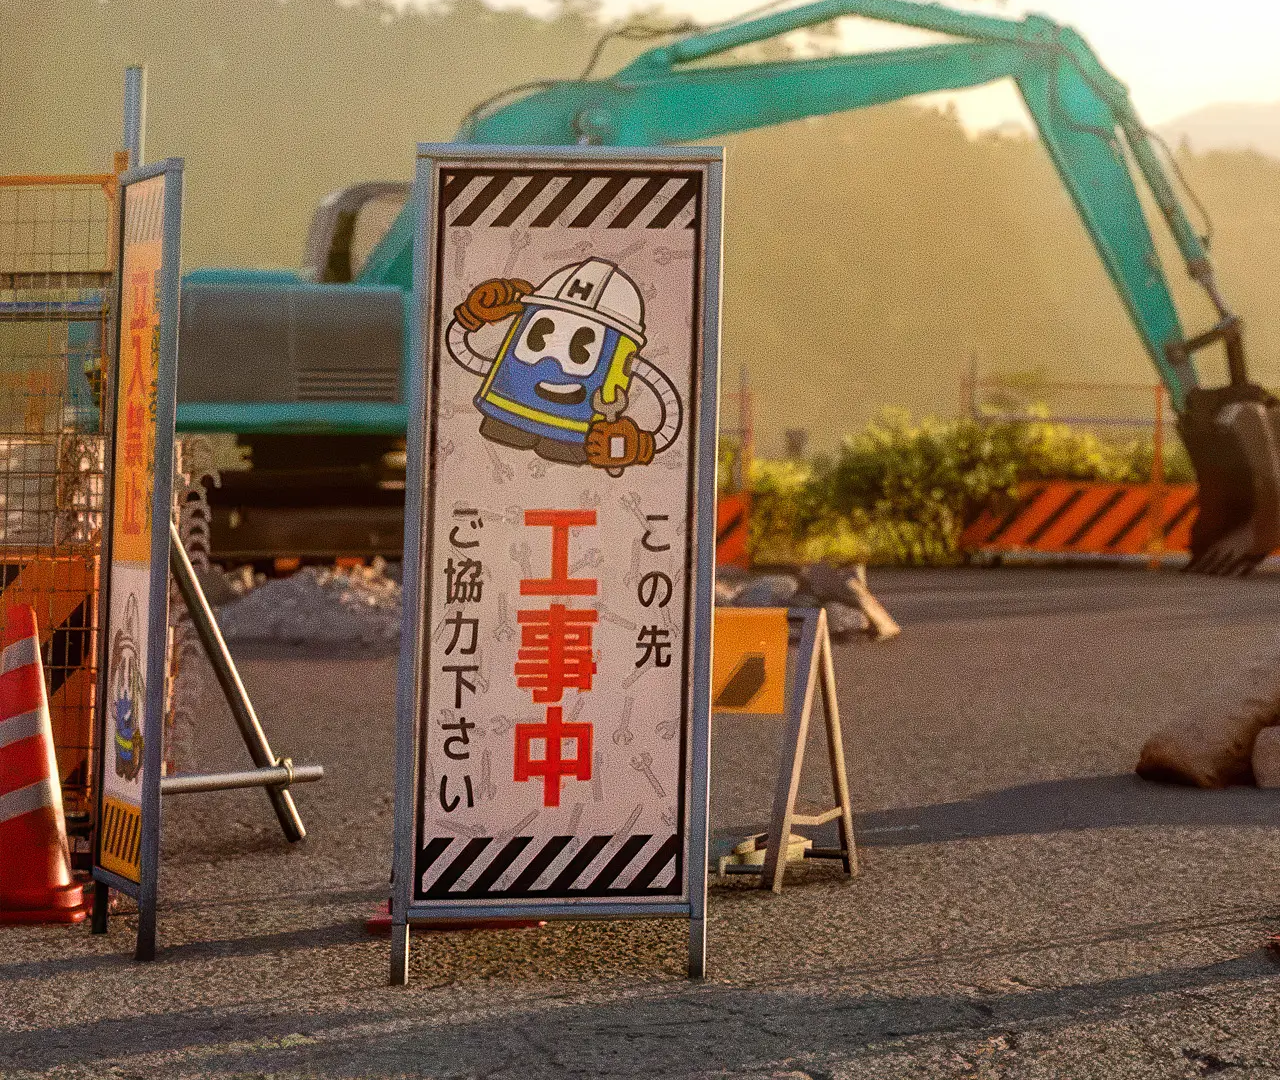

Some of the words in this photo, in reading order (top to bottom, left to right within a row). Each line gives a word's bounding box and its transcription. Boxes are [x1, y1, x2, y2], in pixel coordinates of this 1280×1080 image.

[438, 507, 484, 813] ご協力下さい
[513, 508, 598, 808] 工事中
[634, 514, 674, 669] この先
